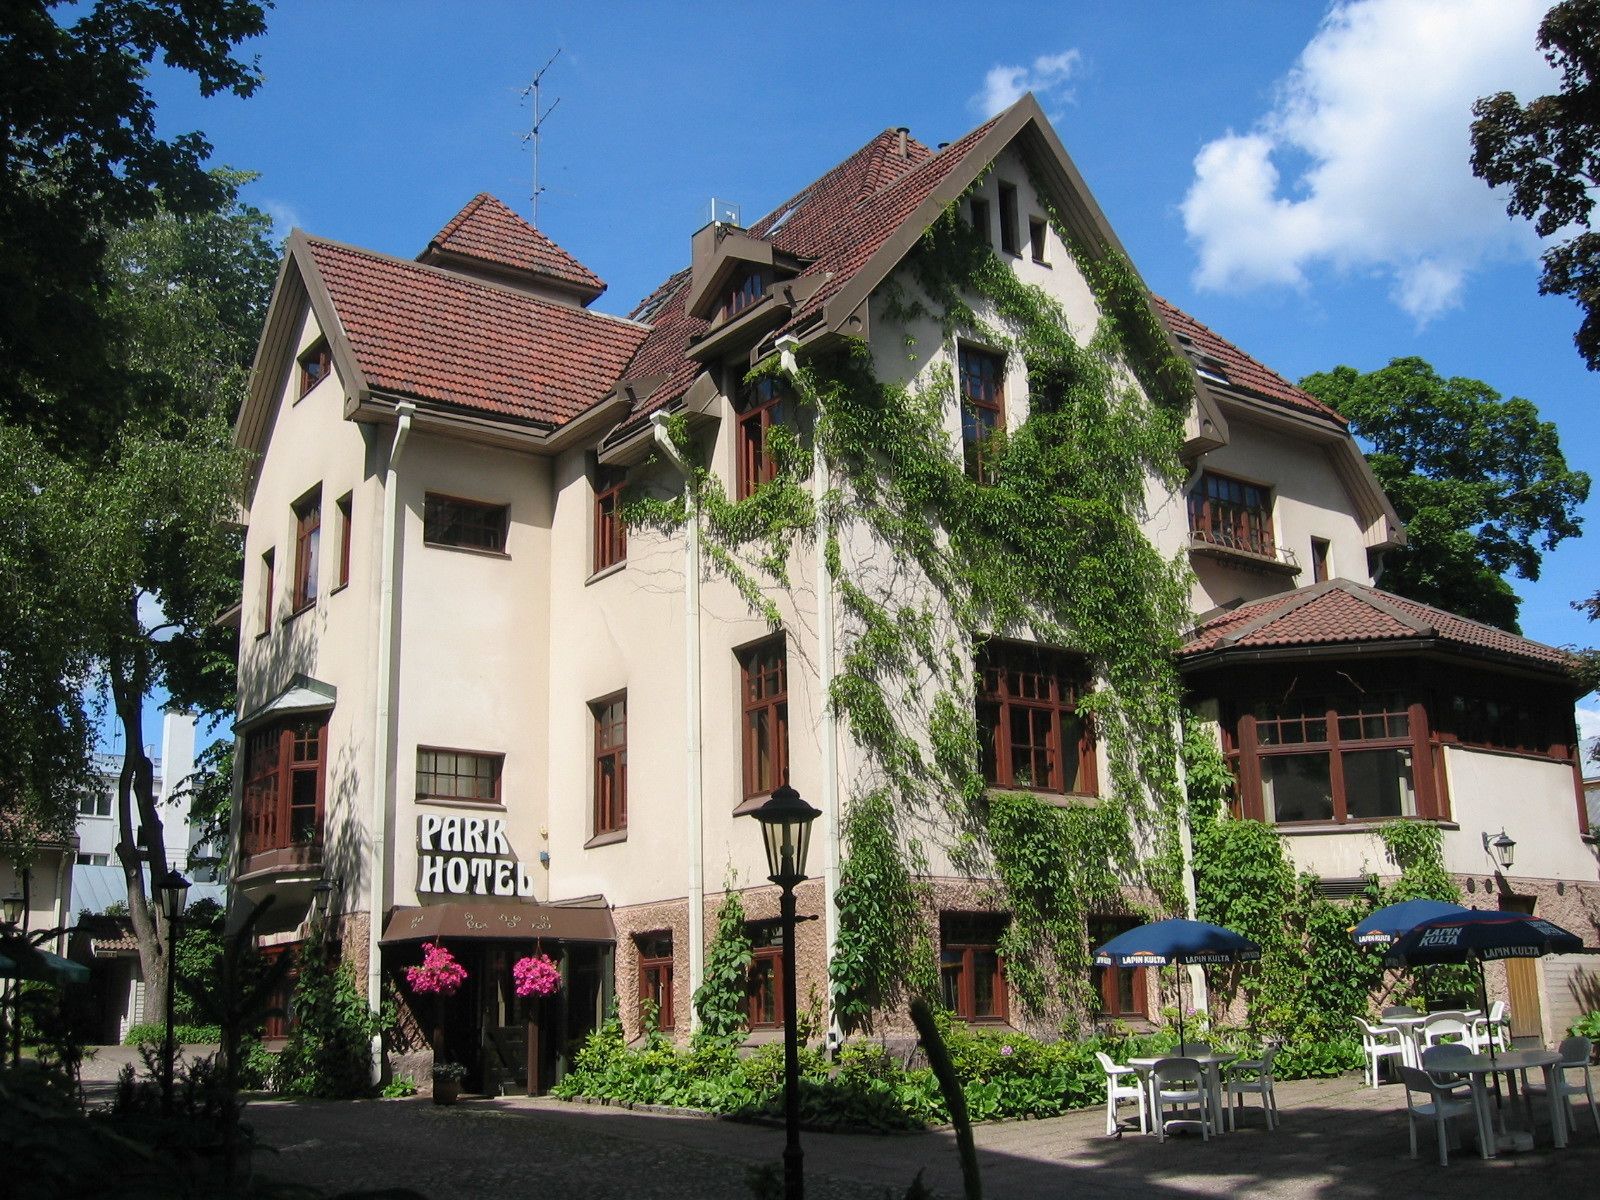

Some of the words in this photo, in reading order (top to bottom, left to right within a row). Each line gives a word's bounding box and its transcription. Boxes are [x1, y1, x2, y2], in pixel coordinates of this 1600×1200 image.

[421, 814, 509, 855] PARK
[419, 855, 535, 897] HOTEL
[1424, 928, 1463, 938] LAPIN
[1419, 936, 1459, 947] KULTA
[1484, 948, 1510, 959] LAPIN
[1511, 946, 1540, 957] KULTA
[1122, 956, 1144, 965] LAPIN
[1144, 955, 1167, 964] KULTA
